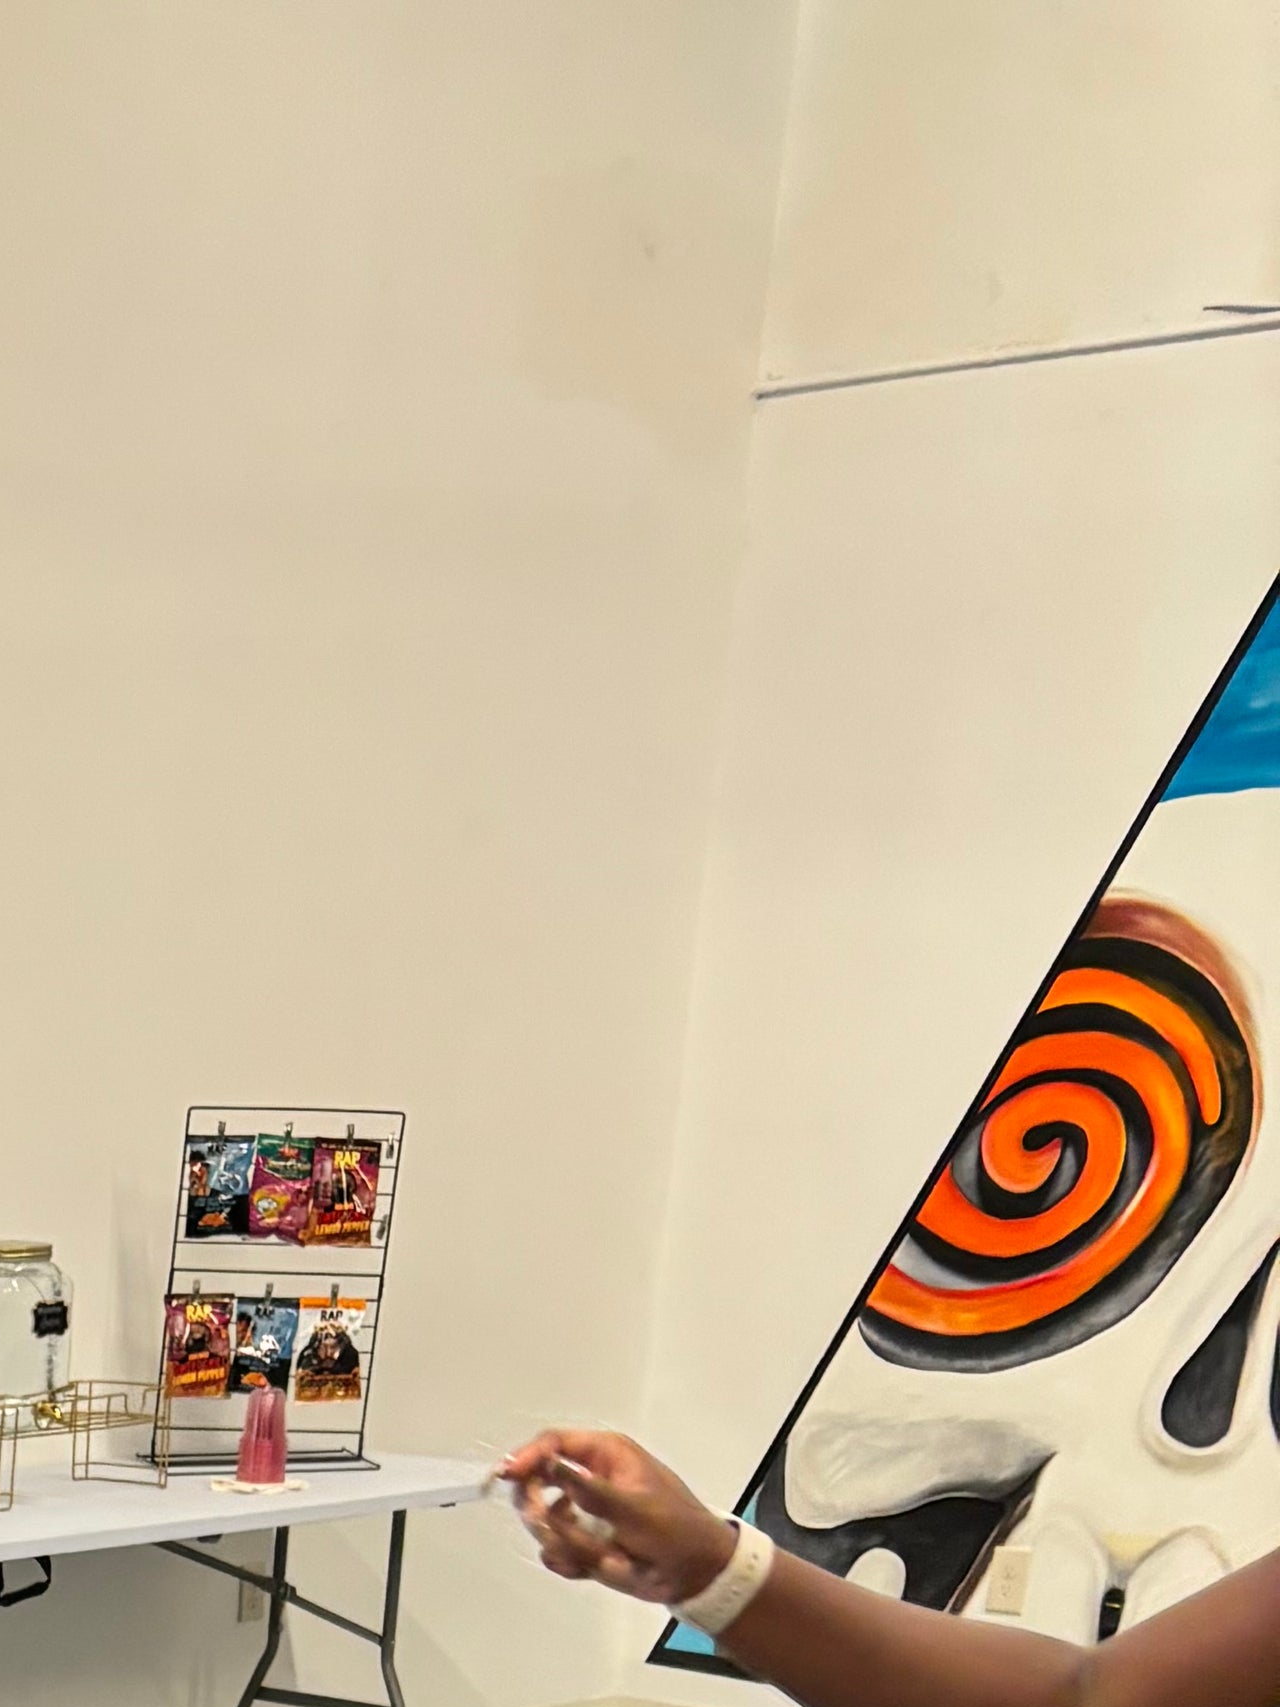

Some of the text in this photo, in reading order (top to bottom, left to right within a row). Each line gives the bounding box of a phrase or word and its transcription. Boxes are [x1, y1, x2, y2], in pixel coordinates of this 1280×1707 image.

[335, 1151, 361, 1166] RAP
[186, 1304, 213, 1320] RAP
[319, 1309, 343, 1322] RAP
